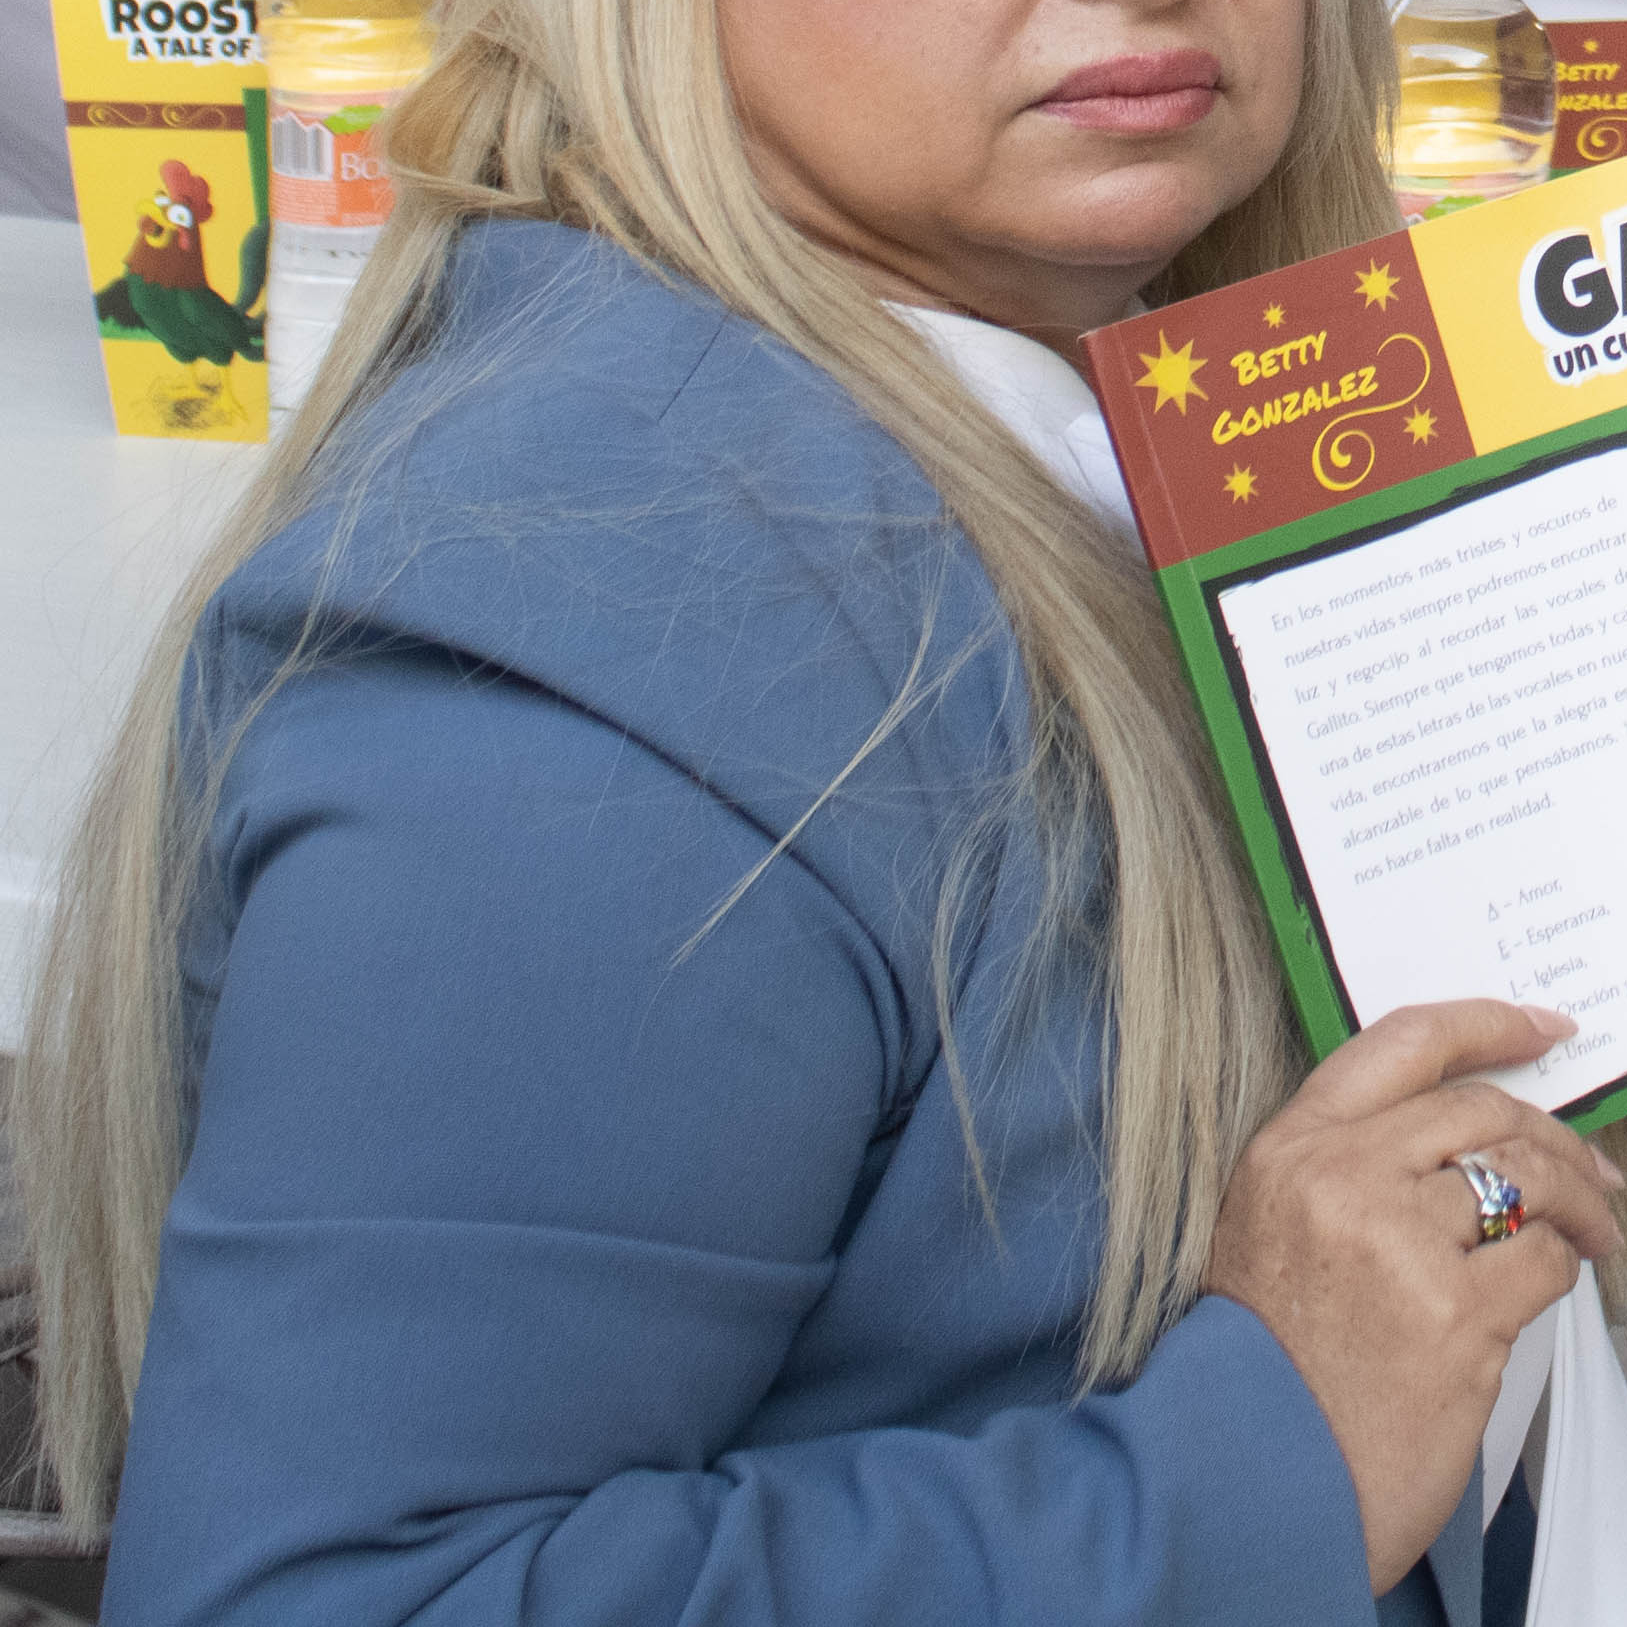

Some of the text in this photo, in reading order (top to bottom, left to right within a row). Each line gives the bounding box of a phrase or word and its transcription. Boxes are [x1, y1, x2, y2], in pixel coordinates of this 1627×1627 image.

[134, 38, 252, 57] A TALE OF
[1230, 329, 1327, 387] BETTY
[1212, 365, 1379, 445] GONZALEZ
[1271, 495, 1617, 632] En los momentos más tristes y oscuros de
[1284, 532, 1626, 668] nuestras vidas siempre podremos encontrar
[1294, 685, 1320, 705] luz
[1328, 678, 1337, 698] y
[1346, 652, 1410, 685] regocijo
[1418, 638, 1432, 658] al
[1440, 614, 1506, 650] recordar
[1514, 604, 1538, 622] las
[1546, 579, 1606, 609] vocales
[1364, 684, 1431, 718] Siempre
[1434, 671, 1464, 695] que
[1467, 641, 1546, 678] tengamos
[1549, 623, 1594, 648] todas
[1598, 617, 1607, 635] y
[1319, 756, 1349, 776] una
[1352, 745, 1373, 763] de
[1375, 729, 1416, 754] estas
[1417, 711, 1462, 738] letras
[1465, 701, 1485, 720] de
[1487, 693, 1511, 711] las
[1514, 670, 1574, 700] vocales
[1577, 661, 1598, 677] en
[1372, 741, 1491, 796] encontraremos
[1496, 726, 1527, 751] que
[1531, 717, 1547, 734] la
[1342, 805, 1424, 850] alcanzable
[1430, 795, 1450, 814] de
[1455, 787, 1472, 803] lo
[1478, 773, 1509, 797] que
[1354, 864, 1383, 885] nos
[1385, 847, 1424, 872] hace
[1426, 832, 1461, 856] falta
[1464, 823, 1485, 840] en
[1519, 878, 1562, 906] Amor,
[1526, 904, 1611, 946] Esperanza,
[1534, 957, 1588, 989] Iglesia,
[1565, 1032, 1616, 1060] Unión.
